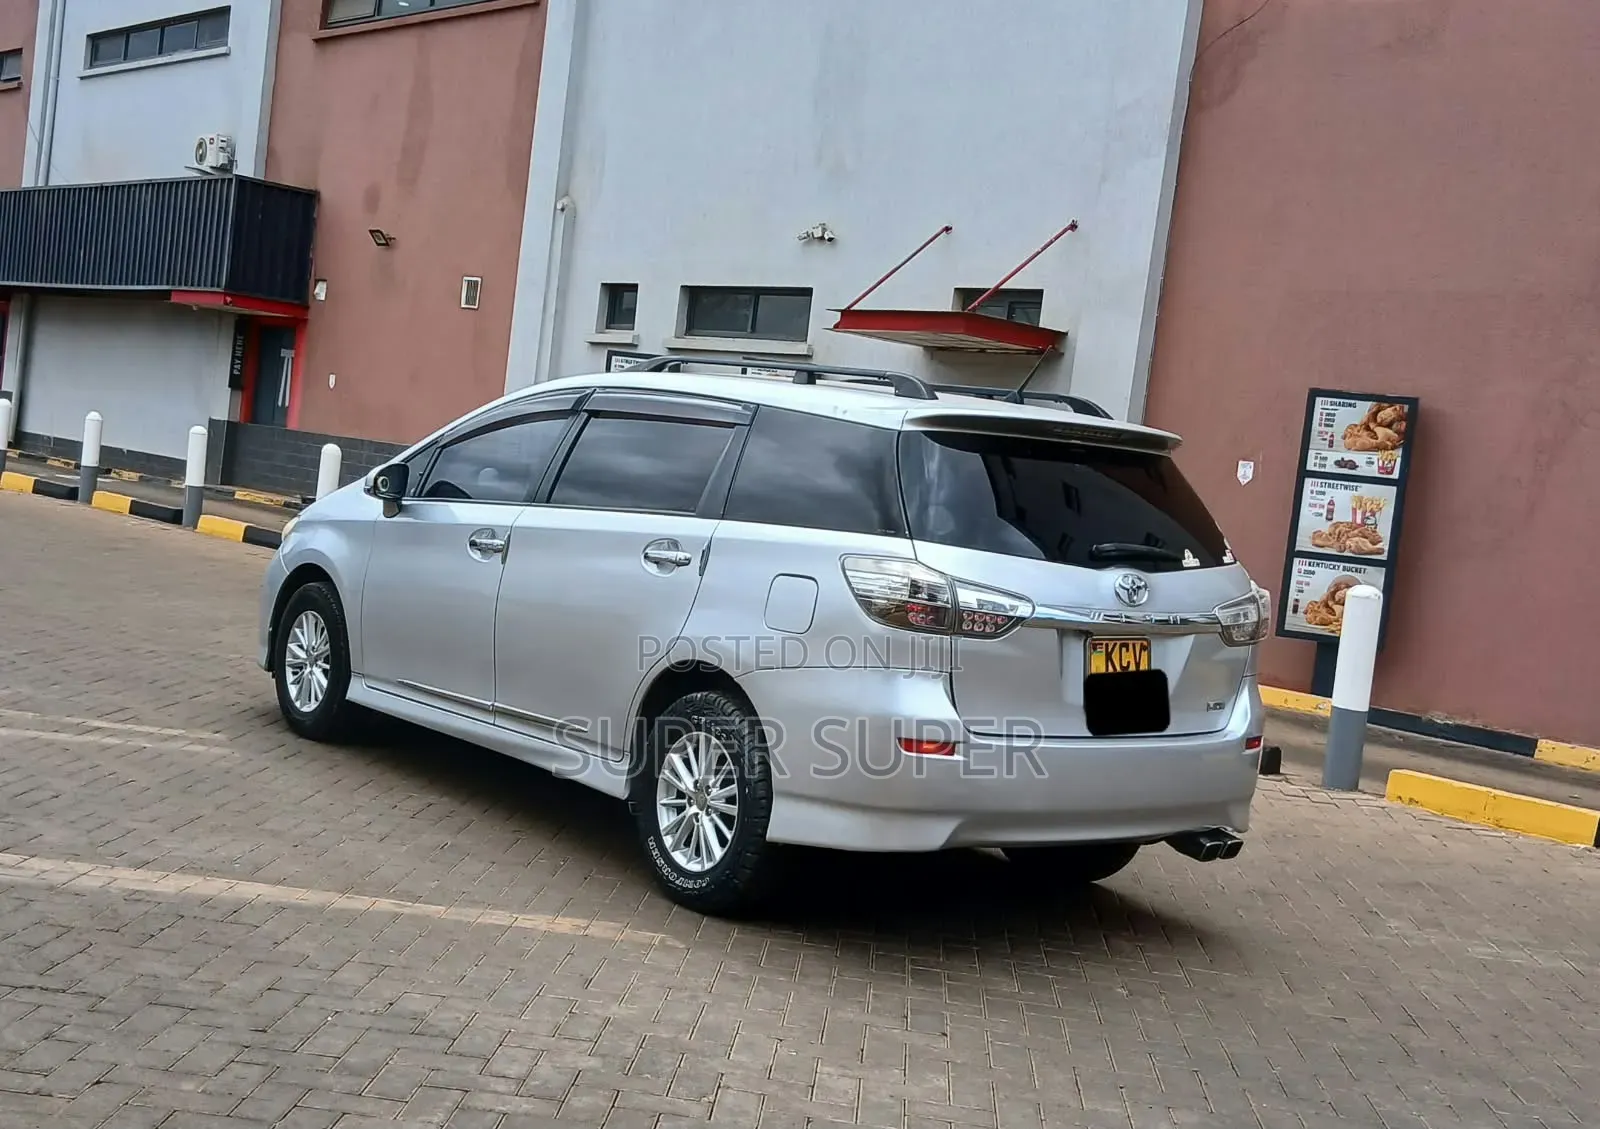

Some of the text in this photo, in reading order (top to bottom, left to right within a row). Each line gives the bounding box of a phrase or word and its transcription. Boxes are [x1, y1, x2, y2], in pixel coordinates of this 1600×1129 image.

[233, 358, 241, 375] PAY
[1329, 400, 1357, 409] SHARING
[1319, 481, 1360, 492] STREETWISE
[1308, 561, 1367, 574] KENTUCKY BUCKET
[1104, 642, 1145, 673] KCV
